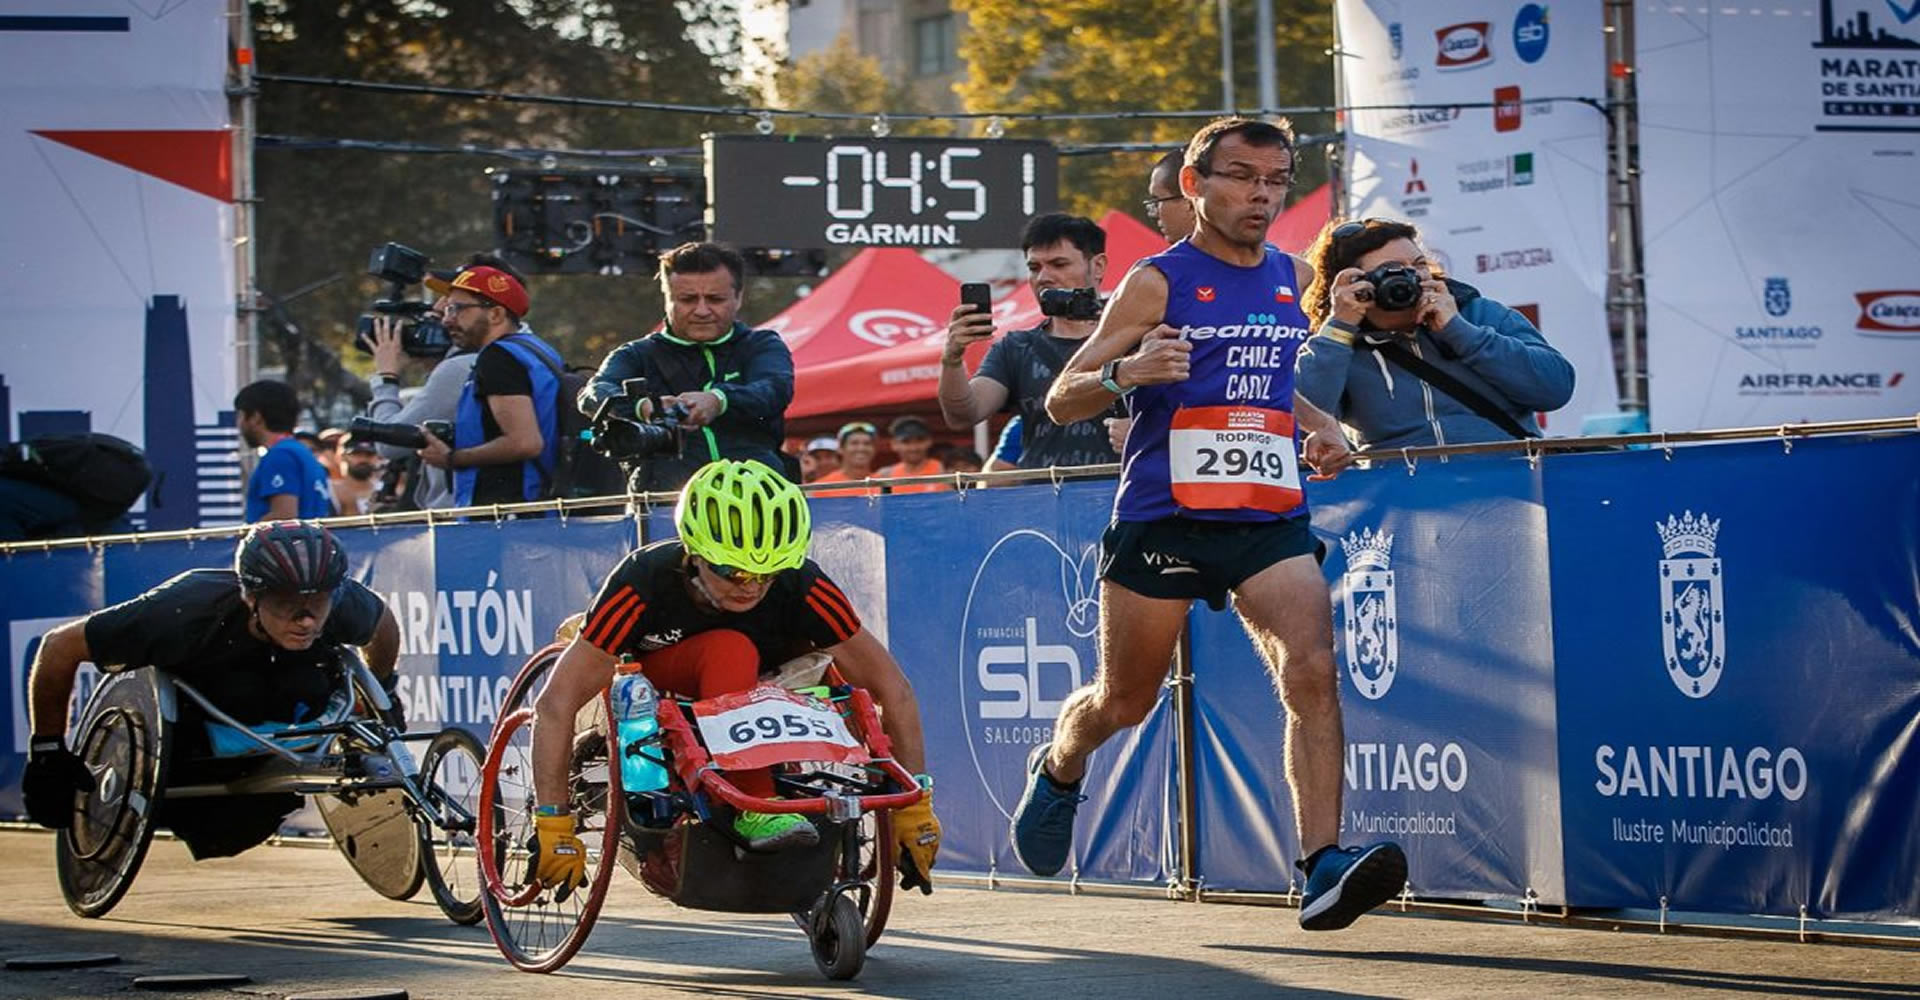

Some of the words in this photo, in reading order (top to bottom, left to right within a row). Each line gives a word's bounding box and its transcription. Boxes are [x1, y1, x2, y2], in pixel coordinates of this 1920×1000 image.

[1821, 58, 1920, 78] MARAT
[1822, 82, 1849, 96] DE
[782, 146, 1035, 221] -04:51
[826, 223, 957, 245] GARMIN
[1736, 326, 1823, 340] SANTIAGO
[1226, 346, 1281, 368] CHILE
[1739, 374, 1882, 388] AIRFRANCE
[1215, 432, 1272, 444] RODRIGO
[1196, 448, 1283, 479] 2949
[390, 570, 534, 655] ARATÓN
[977, 627, 1025, 639] FARMACIAS
[978, 617, 1081, 719] sb
[398, 675, 513, 724] SANTIAG
[729, 714, 834, 743] 6955
[984, 726, 1051, 744] SALCOBR
[1344, 742, 1468, 792] NTIAGO
[1595, 745, 1808, 801] SANTIAGO
[1351, 810, 1456, 839] Municipalidad
[1612, 817, 1665, 843] Ilustre
[1671, 819, 1794, 851] Municipalidad
